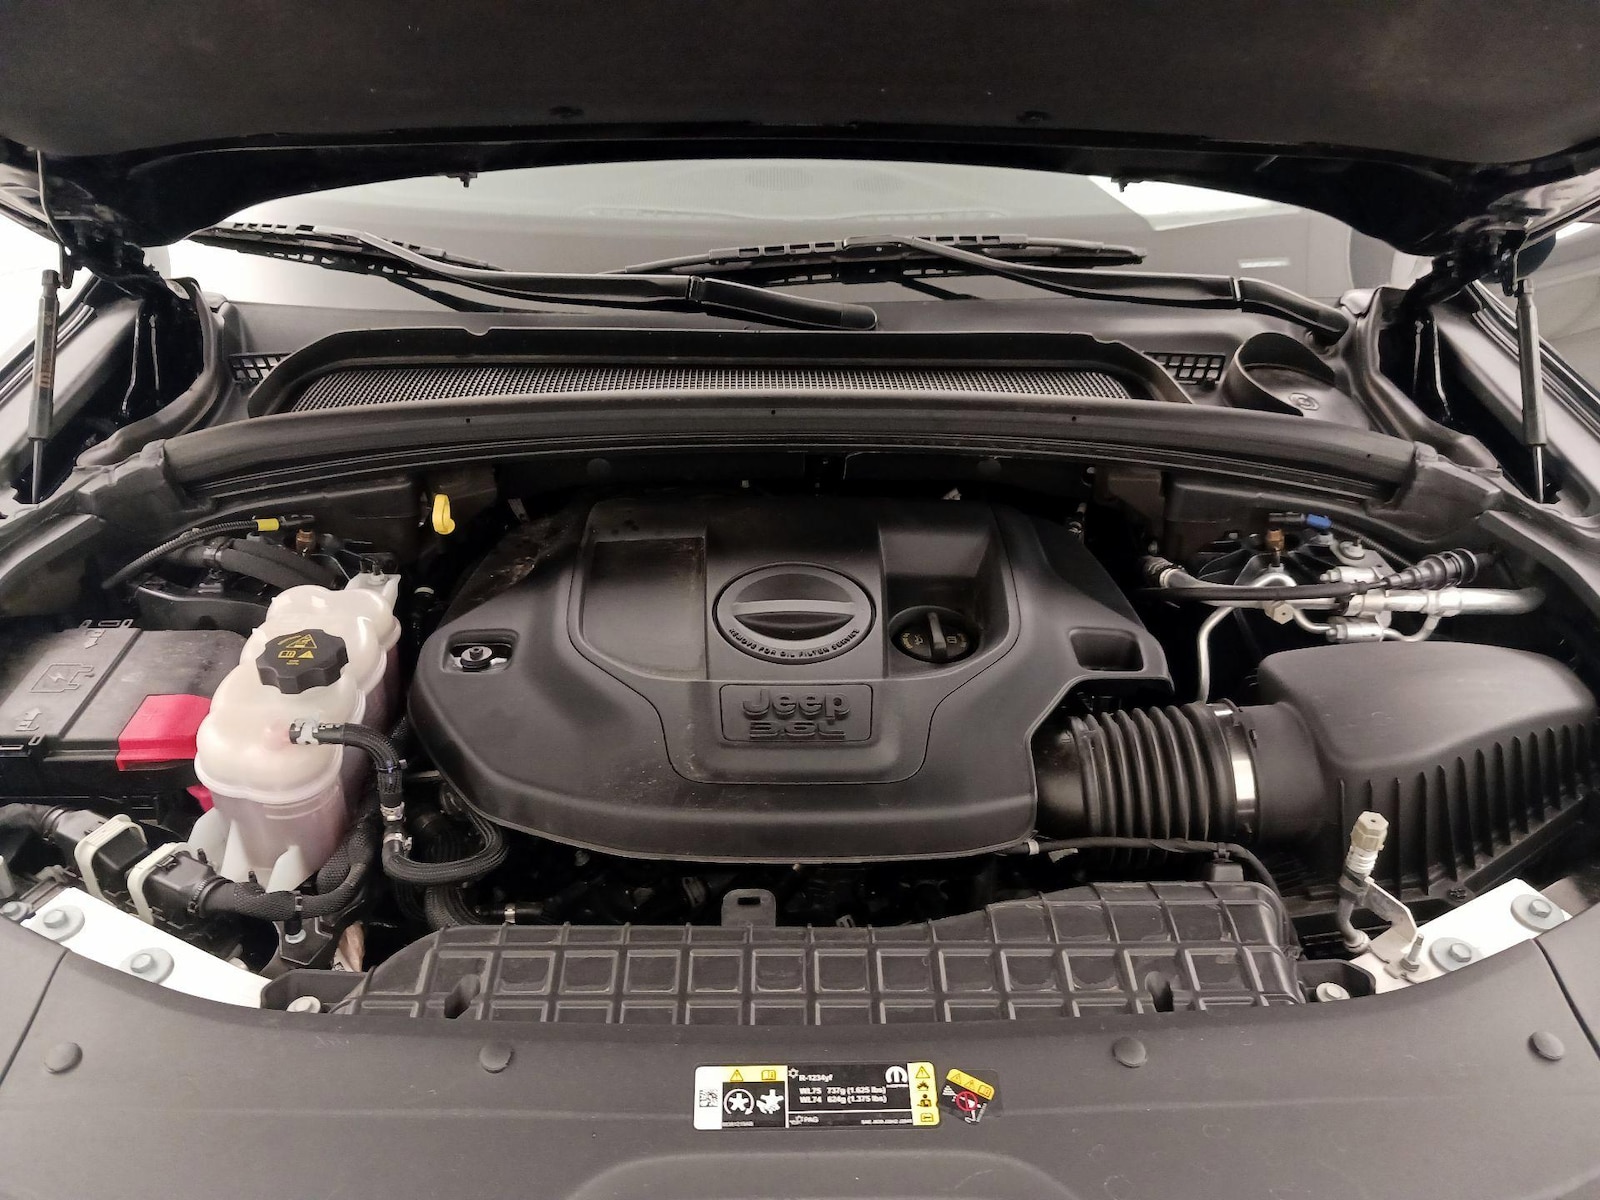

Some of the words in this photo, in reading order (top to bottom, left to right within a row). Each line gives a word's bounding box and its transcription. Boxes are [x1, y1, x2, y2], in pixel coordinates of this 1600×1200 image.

[729, 628, 757, 650] REMOVE
[758, 646, 777, 656] FOR
[798, 648, 830, 658] FILTER
[743, 689, 850, 720] Jeep
[799, 1074, 833, 1083] R-1234yf
